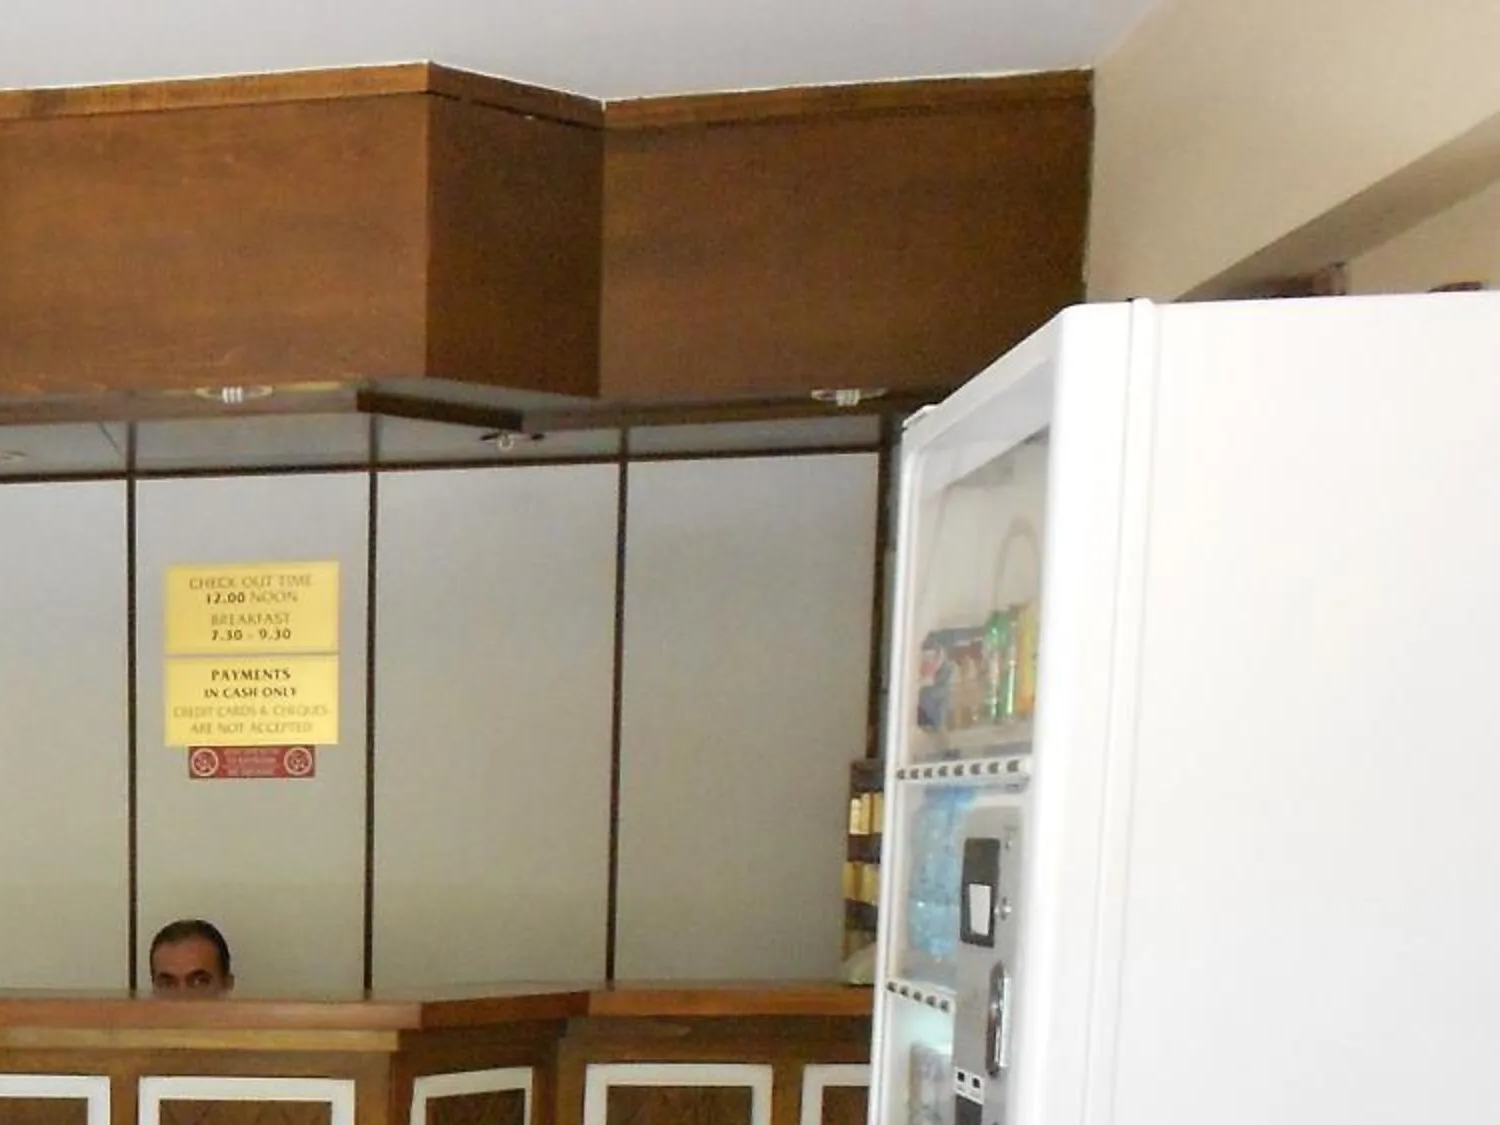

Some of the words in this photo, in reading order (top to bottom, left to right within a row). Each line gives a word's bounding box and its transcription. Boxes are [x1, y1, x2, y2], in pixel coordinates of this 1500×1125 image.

[189, 576, 236, 590] CHECK
[241, 576, 272, 589] OUT
[279, 574, 313, 588] TIME
[206, 592, 246, 604] 12.00
[250, 591, 298, 603] NOON
[211, 612, 291, 626] BREAKFAST
[211, 629, 243, 641] 7.30
[258, 628, 292, 641] 9.30
[211, 668, 292, 681] PAYMENTS
[204, 688, 220, 699] IN
[223, 687, 258, 699] CASH
[261, 686, 297, 698] ONLY
[173, 706, 214, 719] CREDIT
[216, 705, 257, 717] CARDS
[272, 704, 329, 717] CHEQUES
[190, 723, 213, 735] ARE
[217, 722, 245, 734] NOT
[250, 721, 313, 734] ACCEPTED
